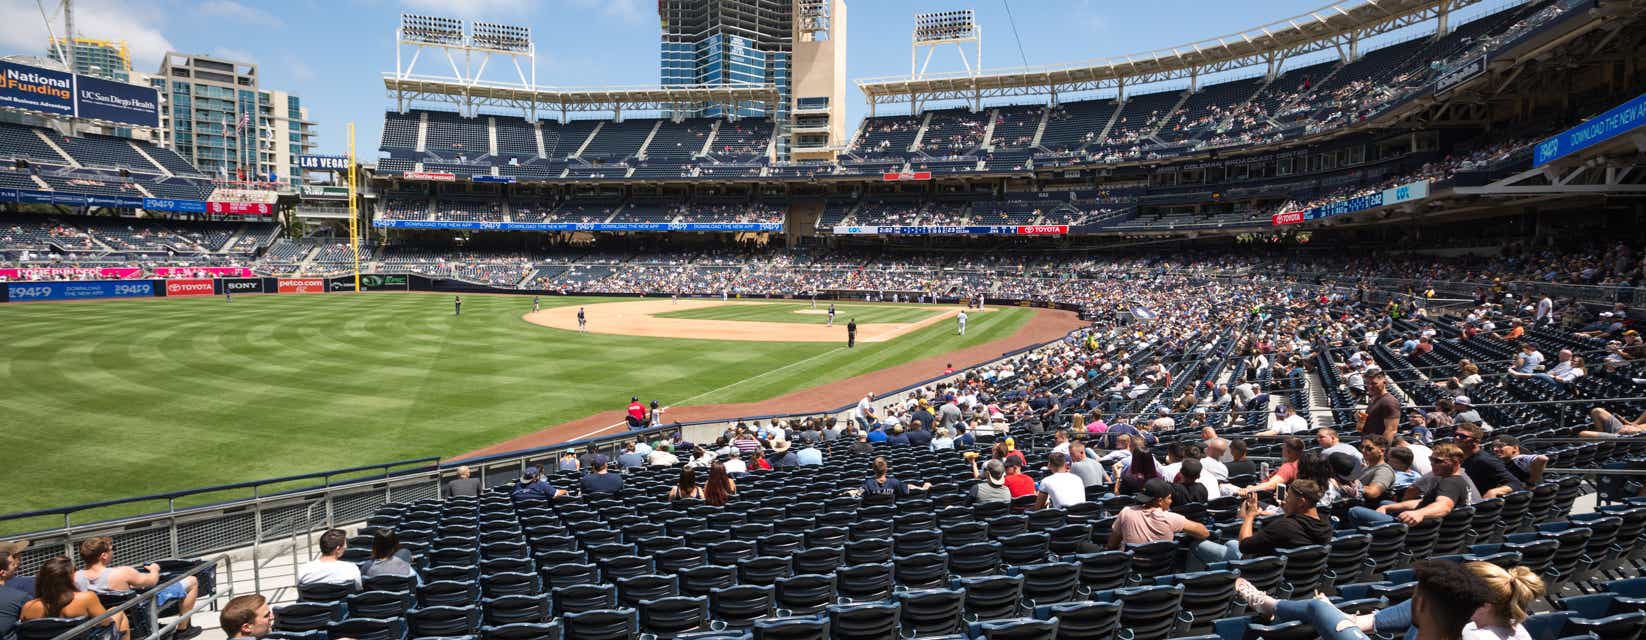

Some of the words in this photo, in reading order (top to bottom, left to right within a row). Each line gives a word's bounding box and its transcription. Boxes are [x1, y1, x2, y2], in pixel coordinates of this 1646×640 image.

[7, 69, 70, 89] National
[8, 79, 70, 100] Funding
[81, 90, 95, 99] UC
[95, 92, 110, 103] San
[111, 95, 132, 108] Diego
[131, 98, 156, 109] Health
[1604, 114, 1618, 131] THE
[1620, 105, 1636, 125] NEW
[301, 157, 318, 168] LAS
[320, 157, 348, 169] VEGAS
[1282, 213, 1300, 222] TOYOTA
[279, 280, 323, 288] petco.com
